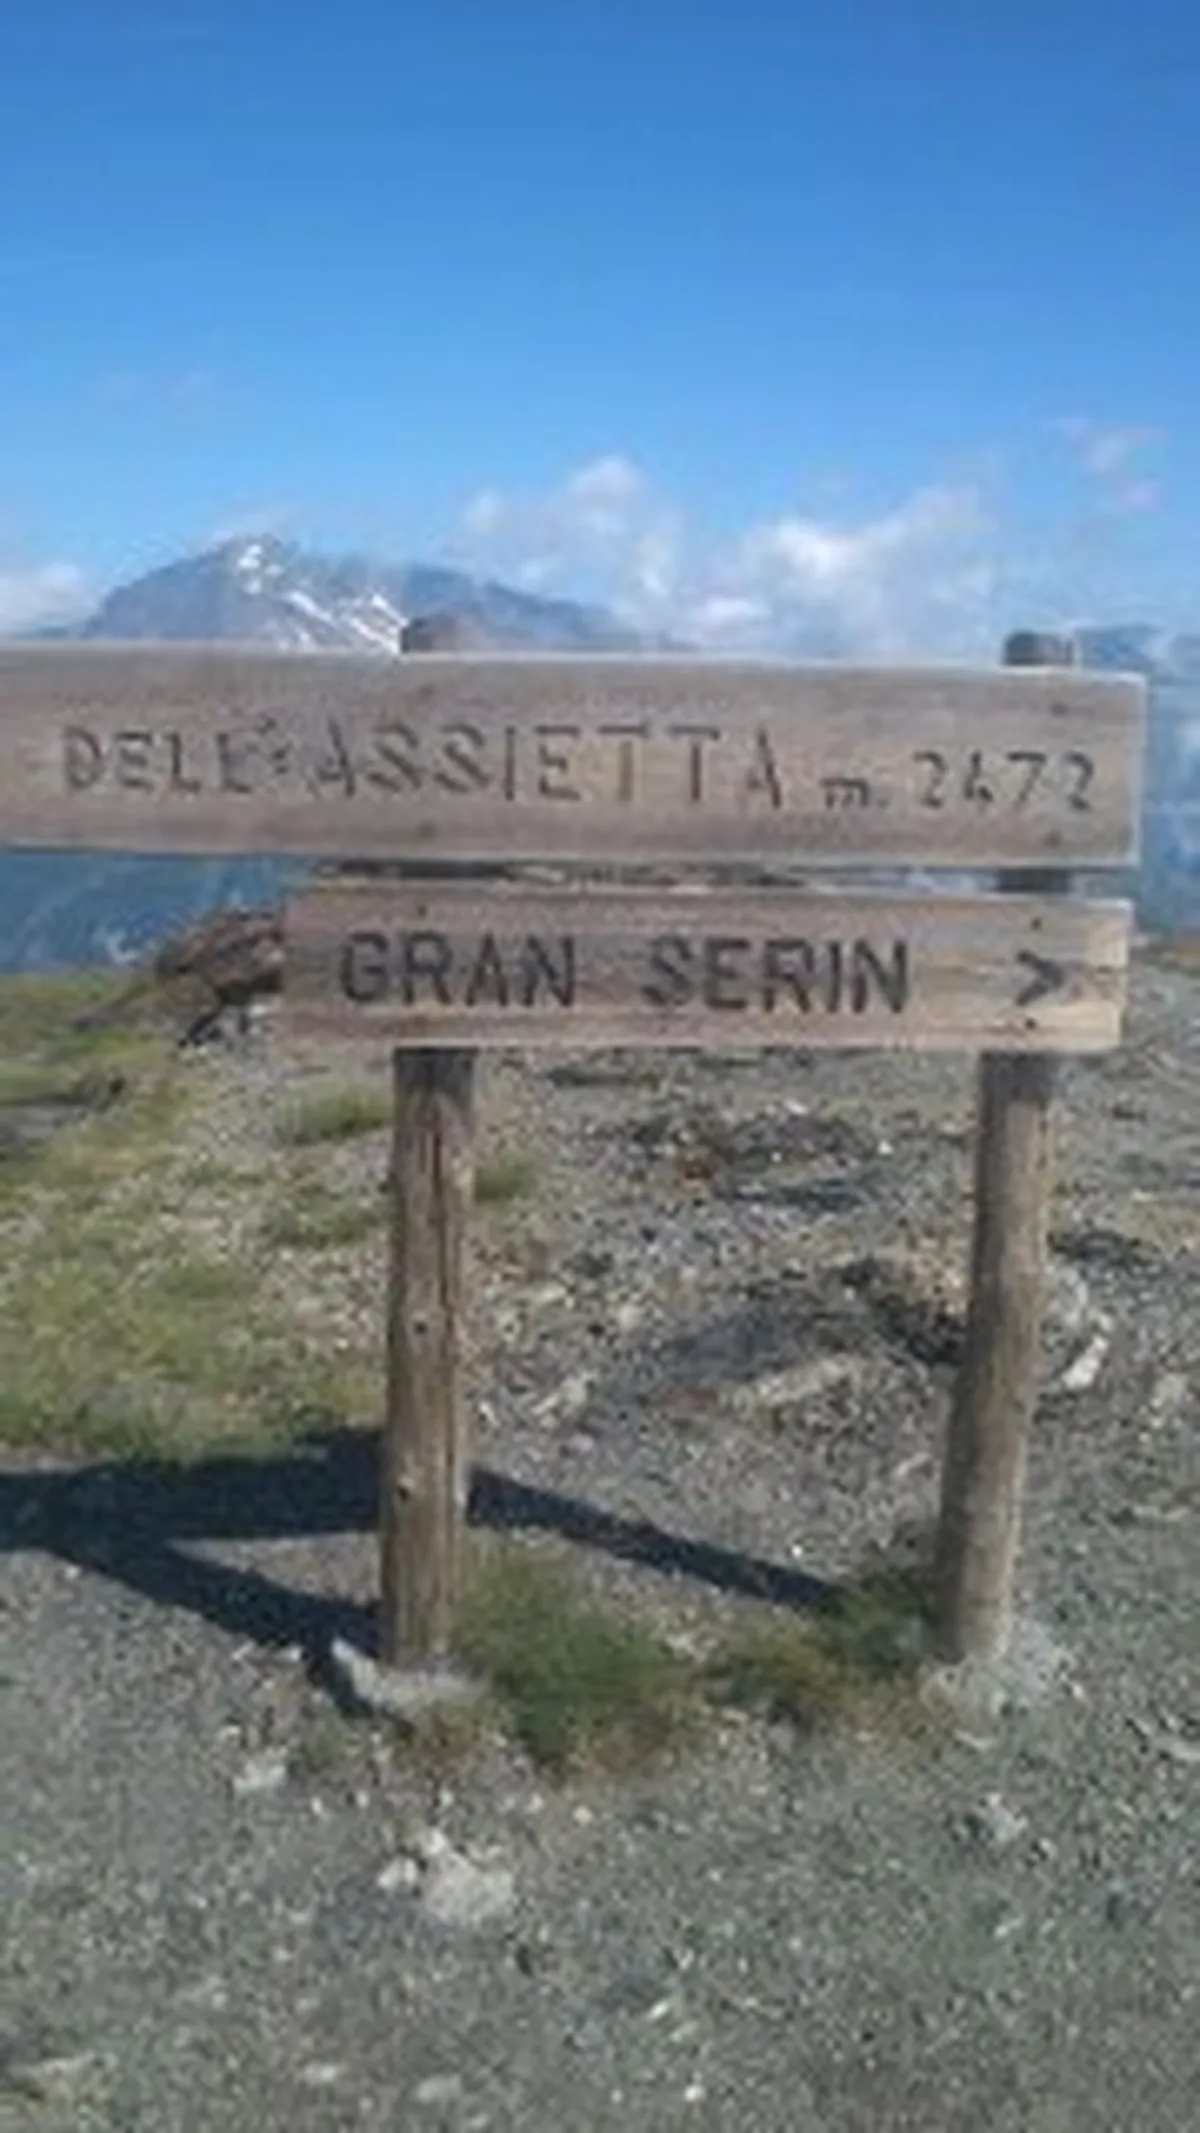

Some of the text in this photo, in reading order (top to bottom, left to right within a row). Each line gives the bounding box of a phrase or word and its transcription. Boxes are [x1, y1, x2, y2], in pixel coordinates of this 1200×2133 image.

[912, 749, 1095, 812] 2472
[339, 929, 910, 1014] GRAN SERIN
